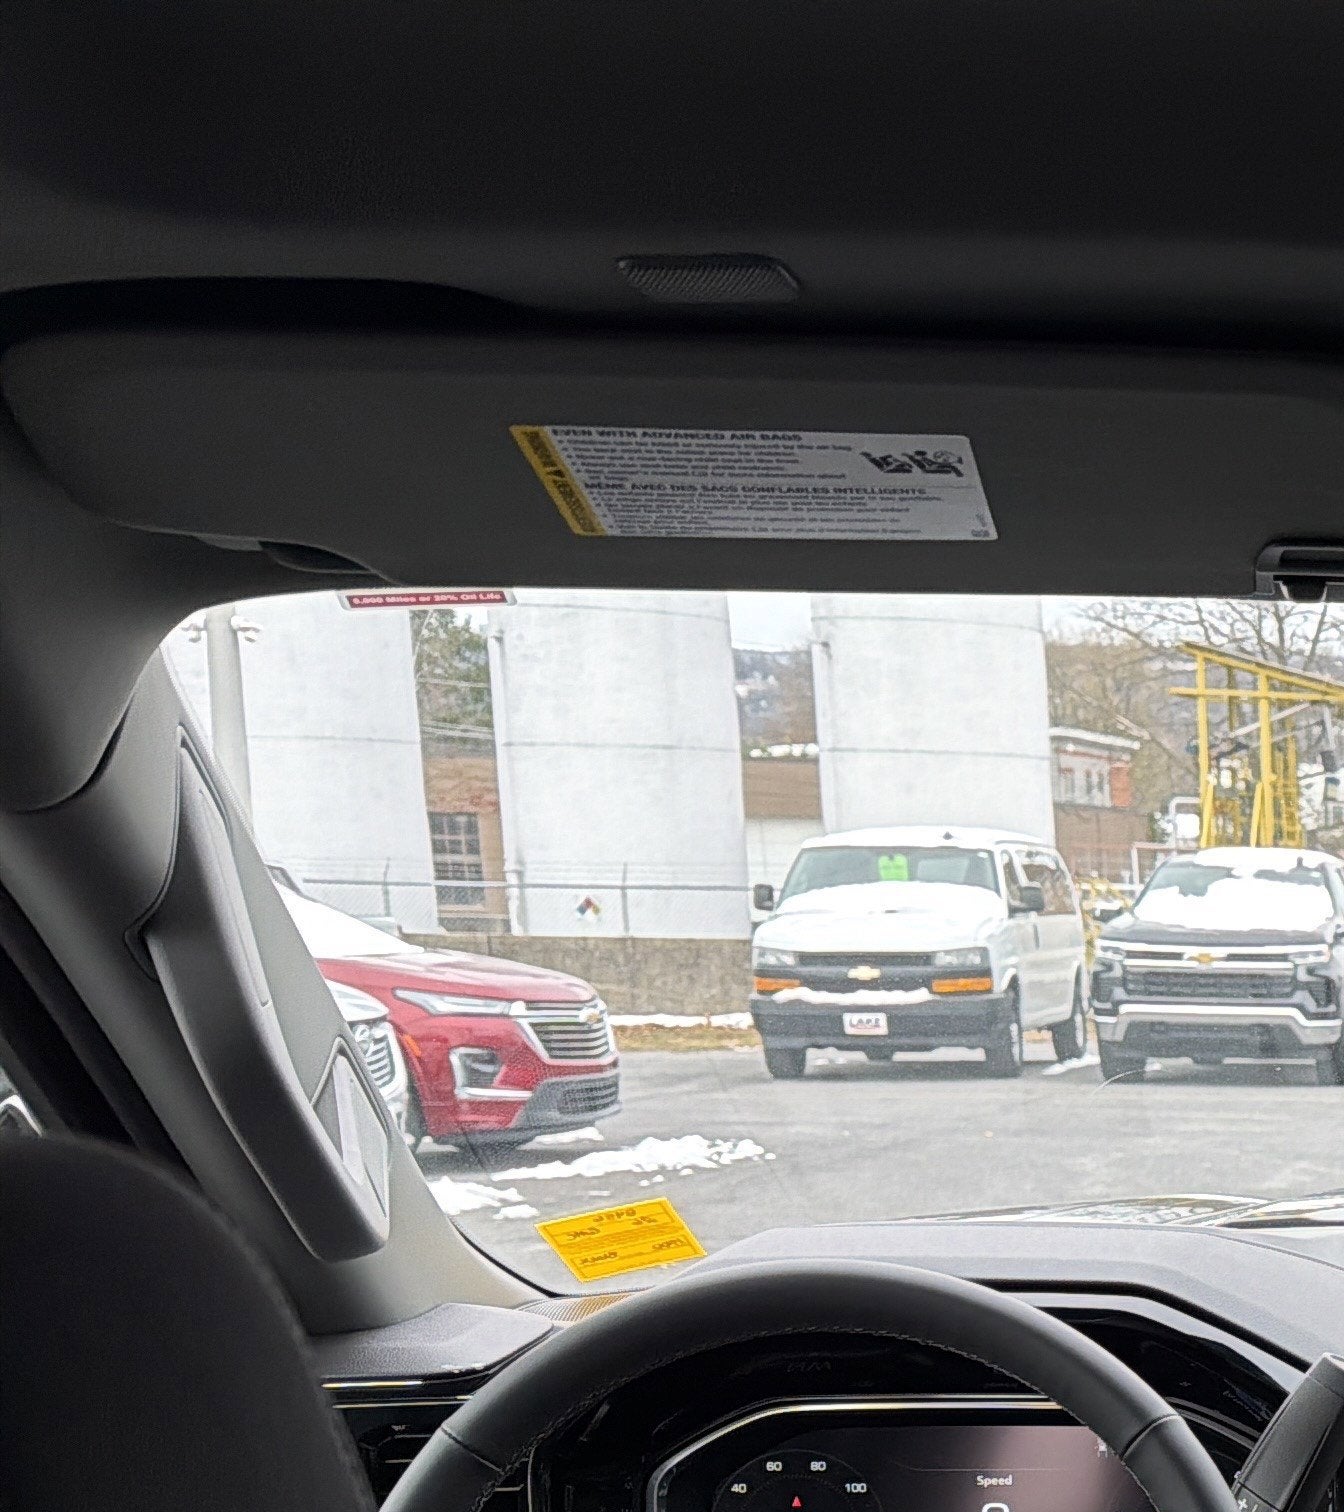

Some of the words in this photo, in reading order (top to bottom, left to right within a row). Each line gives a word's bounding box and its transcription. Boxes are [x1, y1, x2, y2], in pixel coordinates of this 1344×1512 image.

[766, 1461, 782, 1472] 60
[810, 1461, 826, 1472] 80
[976, 1474, 1013, 1488] Speed
[731, 1483, 747, 1494] 40
[845, 1483, 867, 1493] 100
